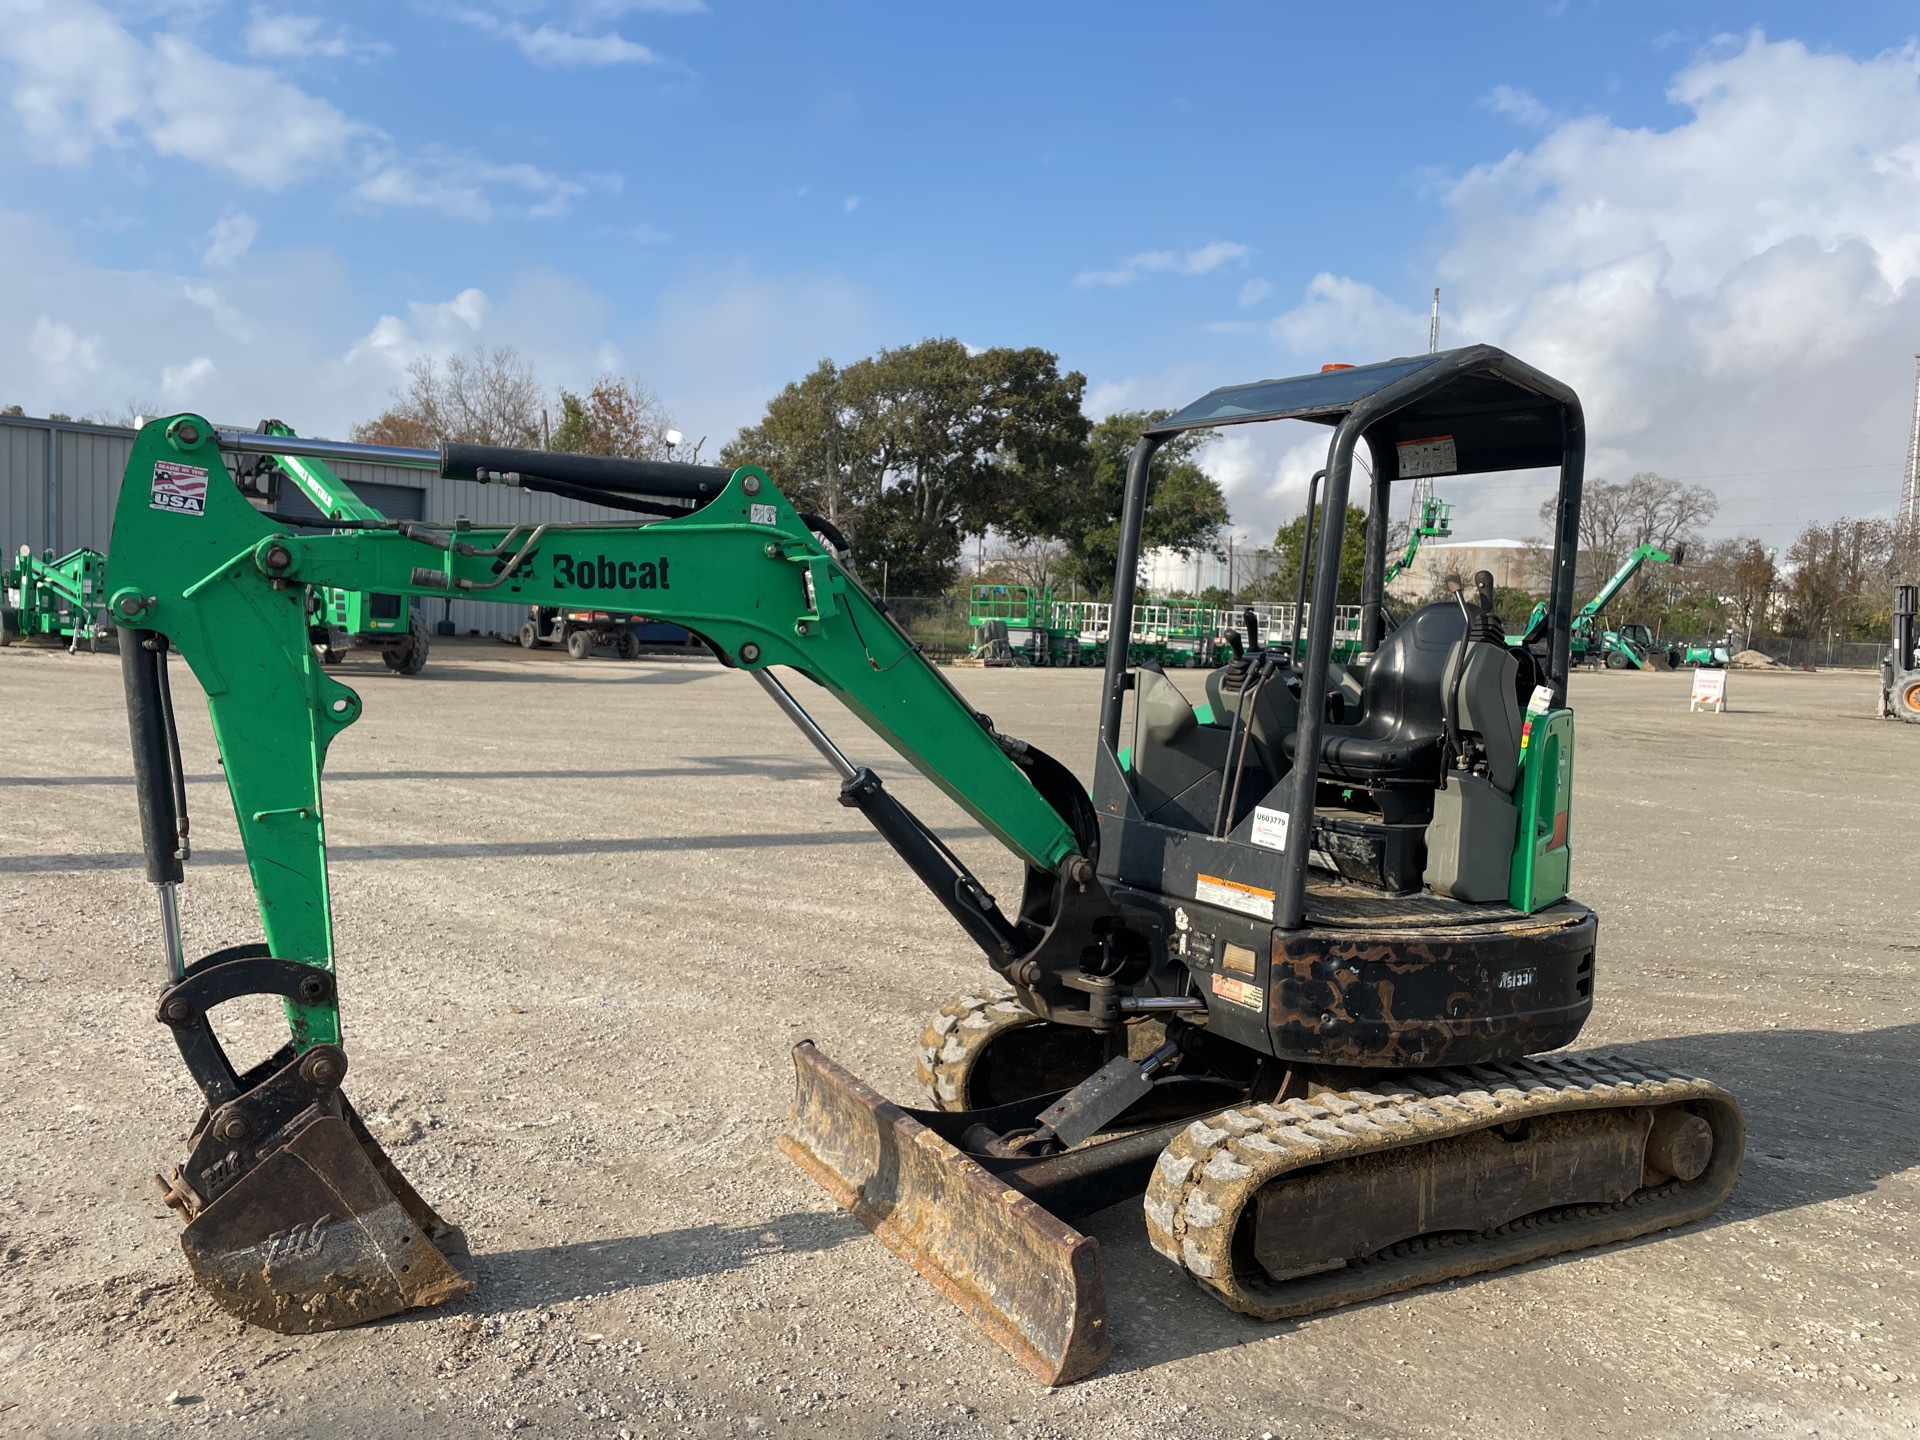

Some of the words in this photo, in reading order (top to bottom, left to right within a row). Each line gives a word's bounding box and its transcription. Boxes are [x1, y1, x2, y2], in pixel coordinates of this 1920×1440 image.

[158, 463, 180, 472] MADE
[154, 492, 200, 511] USA
[553, 554, 670, 590] Bobcat
[1256, 813, 1286, 826] U603779
